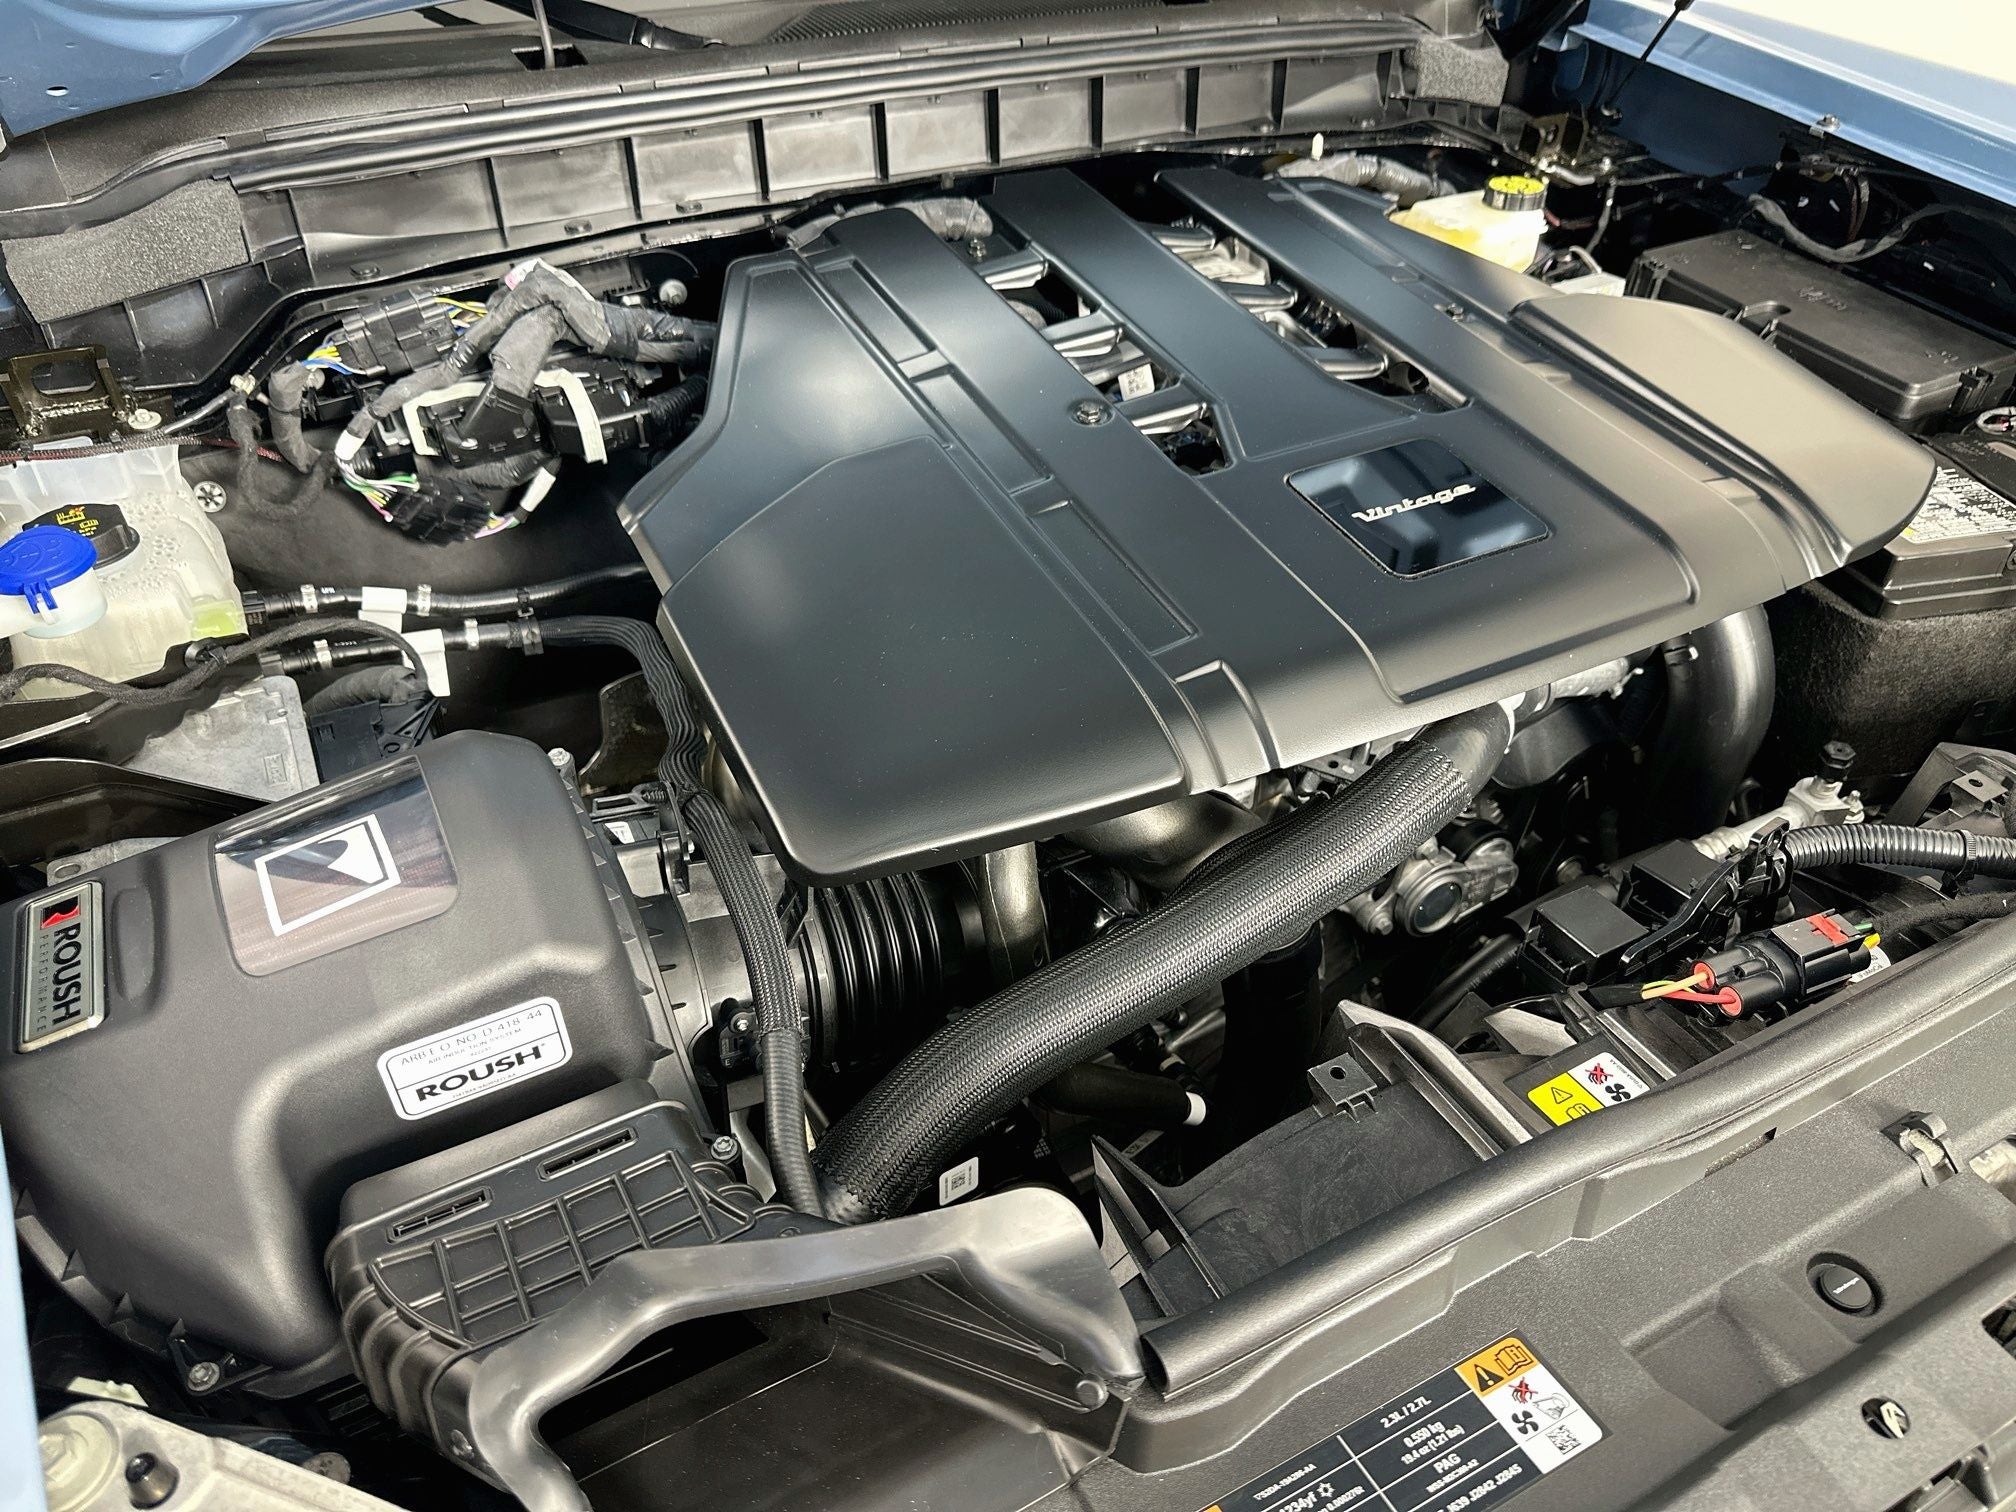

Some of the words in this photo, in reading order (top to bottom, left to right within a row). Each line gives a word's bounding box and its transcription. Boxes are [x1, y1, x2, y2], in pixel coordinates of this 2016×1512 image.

[1351, 483, 1476, 522] Vintage
[37, 934, 50, 1034] PERFORMANCE
[53, 922, 82, 1026] ROUSH
[415, 1045, 542, 1102] ROUSH
[1380, 1411, 1406, 1429] 2.3L
[1403, 1427, 1432, 1448] 0.550
[1427, 1421, 1446, 1434] kg
[1418, 1445, 1431, 1456] oz
[1433, 1453, 1461, 1474] PAG
